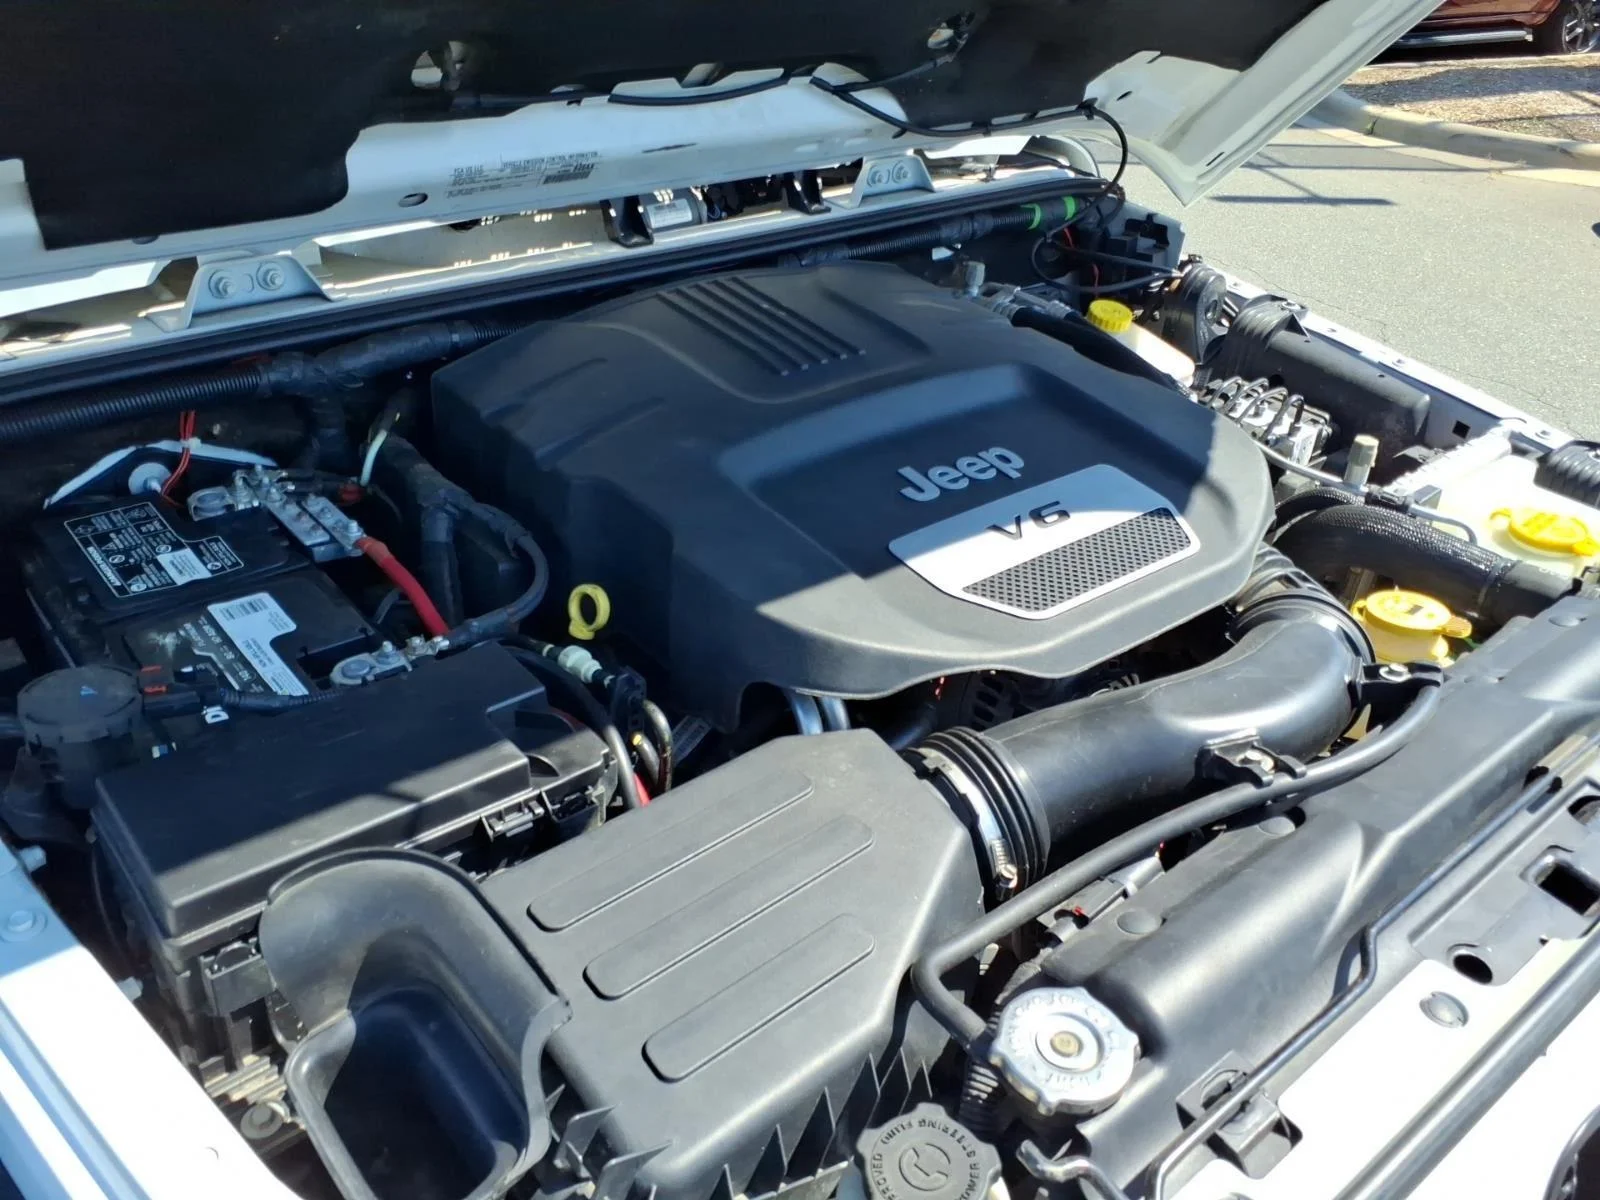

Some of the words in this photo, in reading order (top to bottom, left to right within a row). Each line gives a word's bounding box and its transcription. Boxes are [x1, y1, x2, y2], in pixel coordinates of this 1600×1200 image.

[897, 446, 1025, 502] Jeep
[985, 500, 1071, 541] V6
[957, 1162, 980, 1200] OWER
